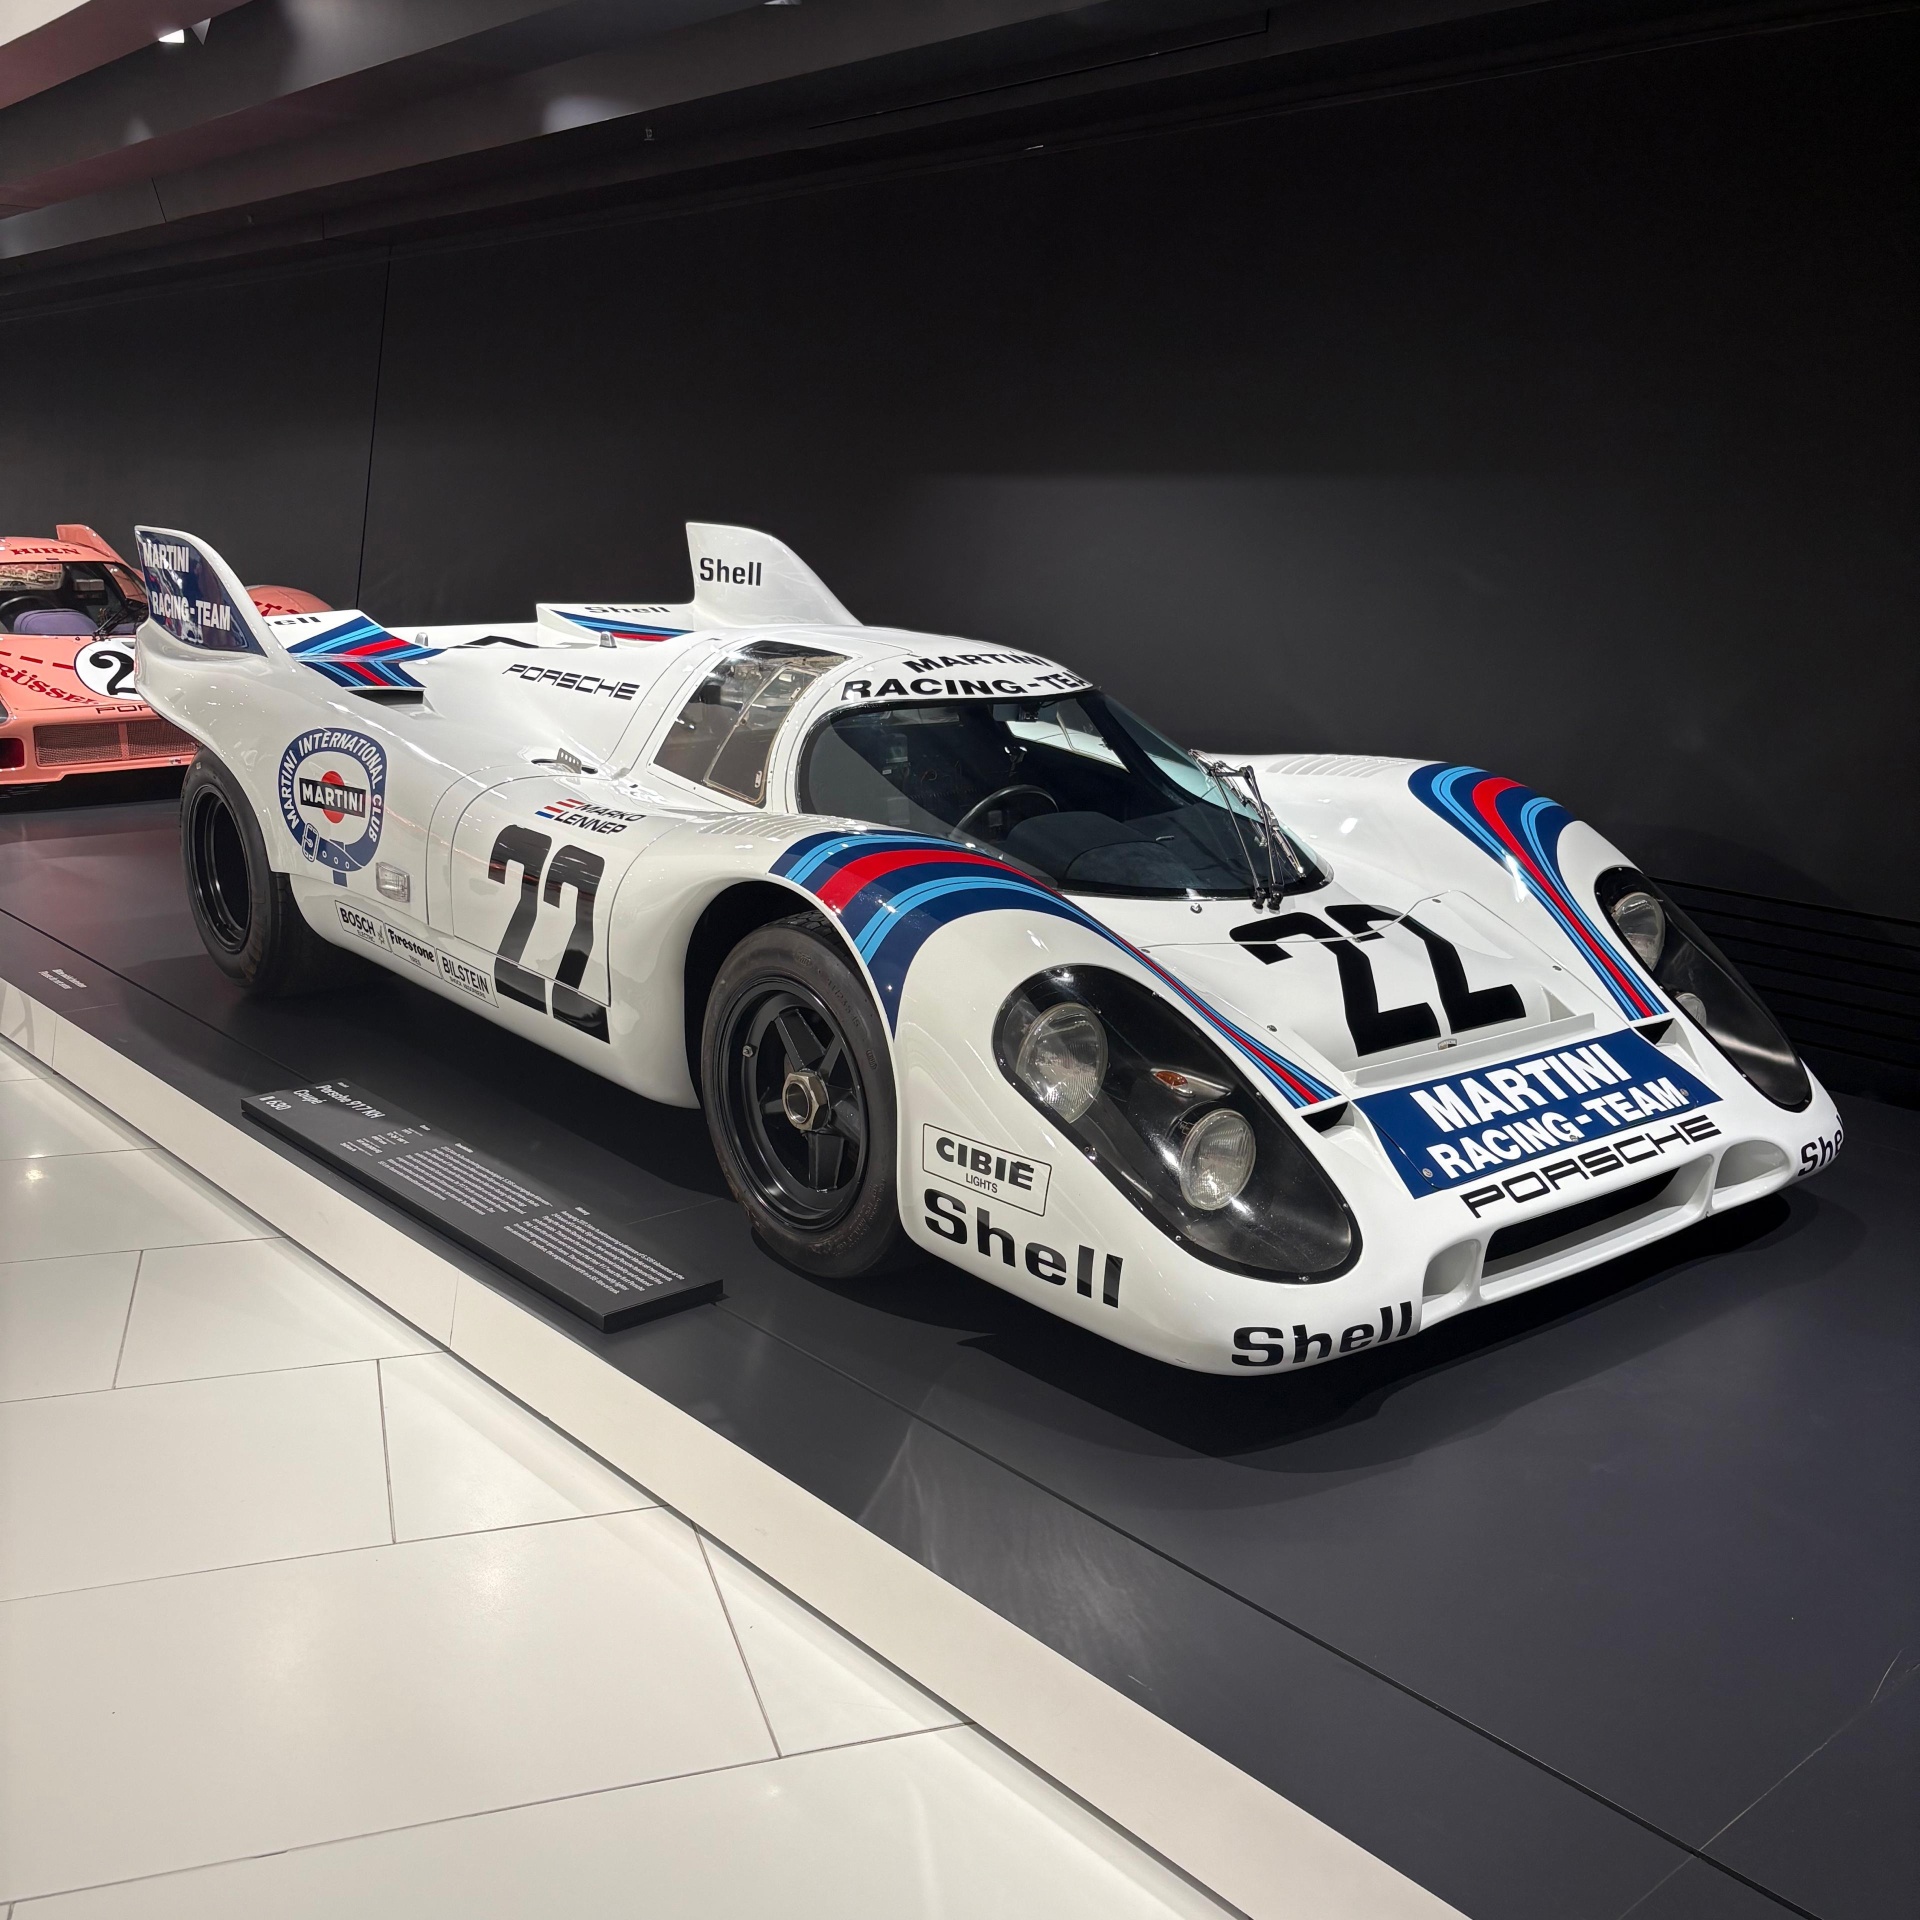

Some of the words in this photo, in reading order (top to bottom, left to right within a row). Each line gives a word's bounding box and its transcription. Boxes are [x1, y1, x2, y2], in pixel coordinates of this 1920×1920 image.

[10, 547, 82, 556] HIRN
[143, 543, 190, 573] MARTINI
[699, 557, 762, 587] Shell
[585, 606, 672, 614] Shell
[902, 653, 1054, 674] MARTINI
[502, 663, 641, 701] PORSCHE
[281, 749, 299, 830] MARTINI
[298, 731, 383, 790] INTERNATIONAL
[367, 793, 382, 843] CLUB
[302, 782, 364, 813] MARTINI
[553, 811, 628, 835] LENNEP
[574, 803, 647, 822] MARKO
[339, 907, 376, 937] BOSCH
[487, 824, 612, 1045] 22
[388, 929, 435, 963] Firestone
[441, 956, 490, 994] BILSTEIN
[1229, 904, 1527, 1057] 22
[293, 1089, 327, 1105] Coupé
[315, 1084, 352, 1103] Porsche
[346, 1100, 373, 1111] 917
[1409, 1043, 1633, 1133] MARTINI
[1426, 1077, 1690, 1179] RACING-TEAM
[1459, 1114, 1722, 1218] PORSCHE
[965, 1172, 998, 1194] LIGHTS
[924, 1188, 1123, 1309] Shell
[1231, 1301, 1413, 1367] Shell
